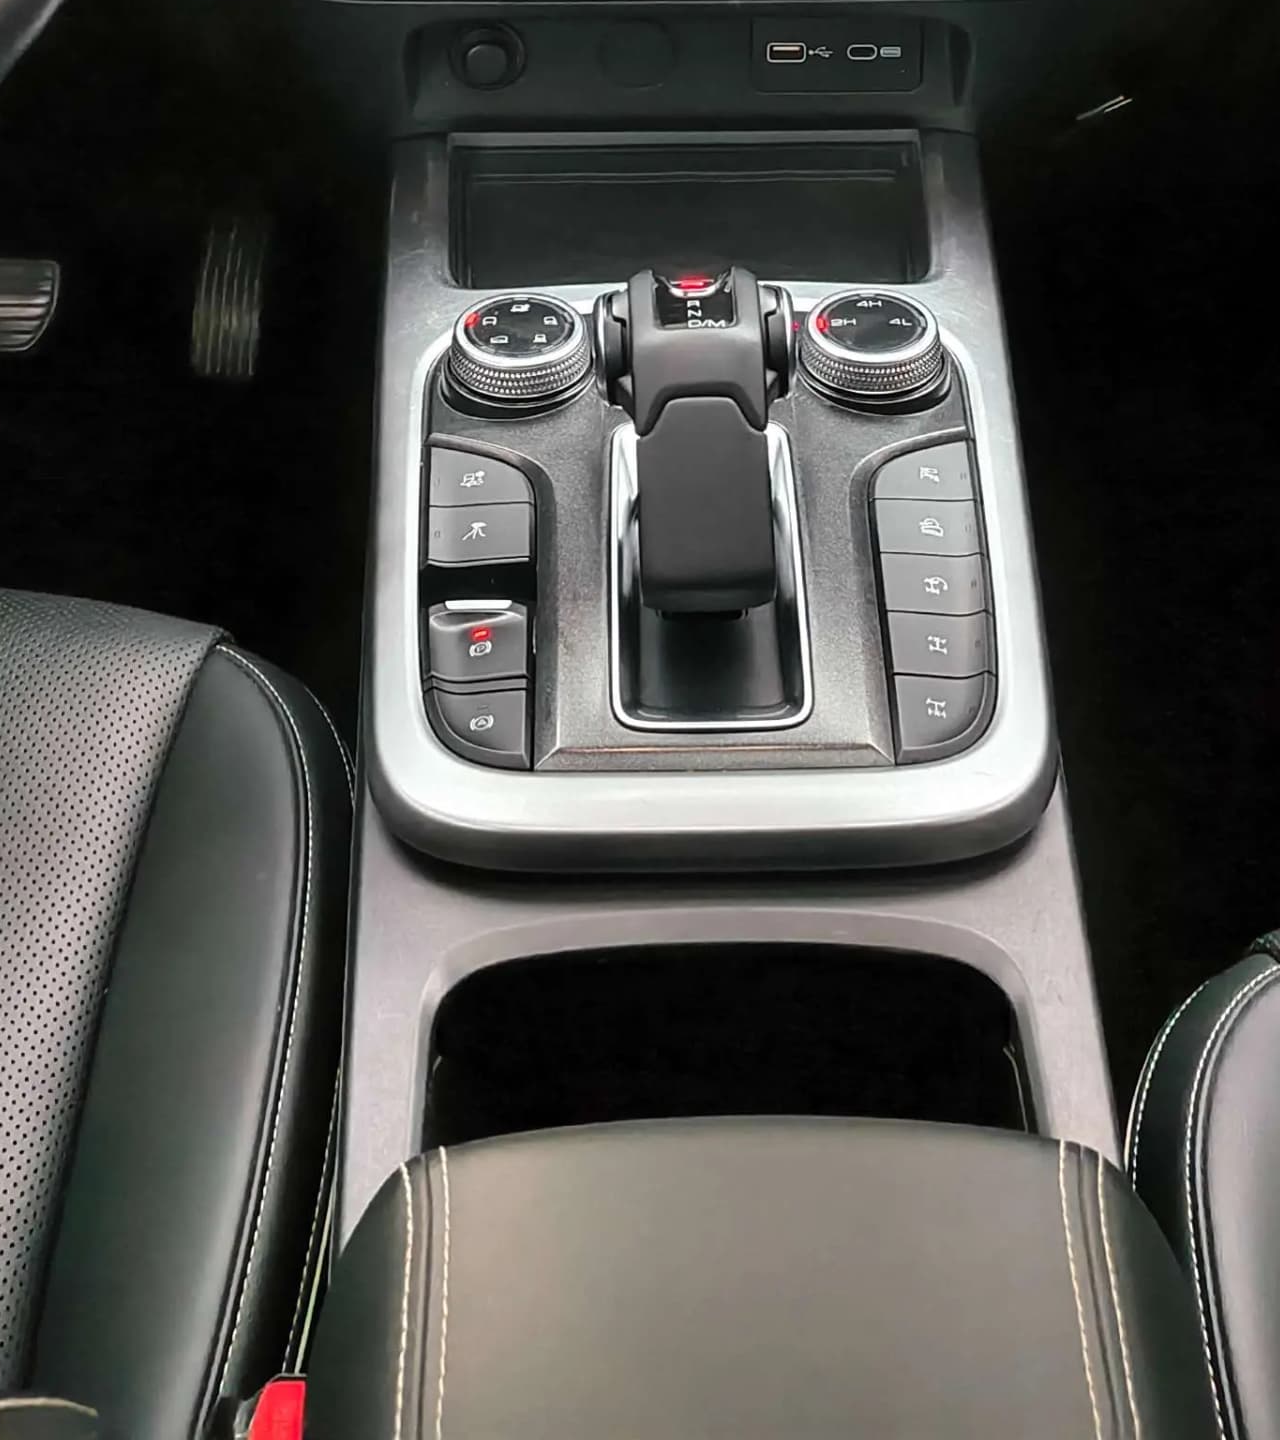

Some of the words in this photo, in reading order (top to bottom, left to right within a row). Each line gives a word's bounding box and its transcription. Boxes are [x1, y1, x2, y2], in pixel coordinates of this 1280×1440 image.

[856, 300, 883, 308] 4H
[687, 319, 727, 328] D/M
[888, 318, 913, 326] 4L
